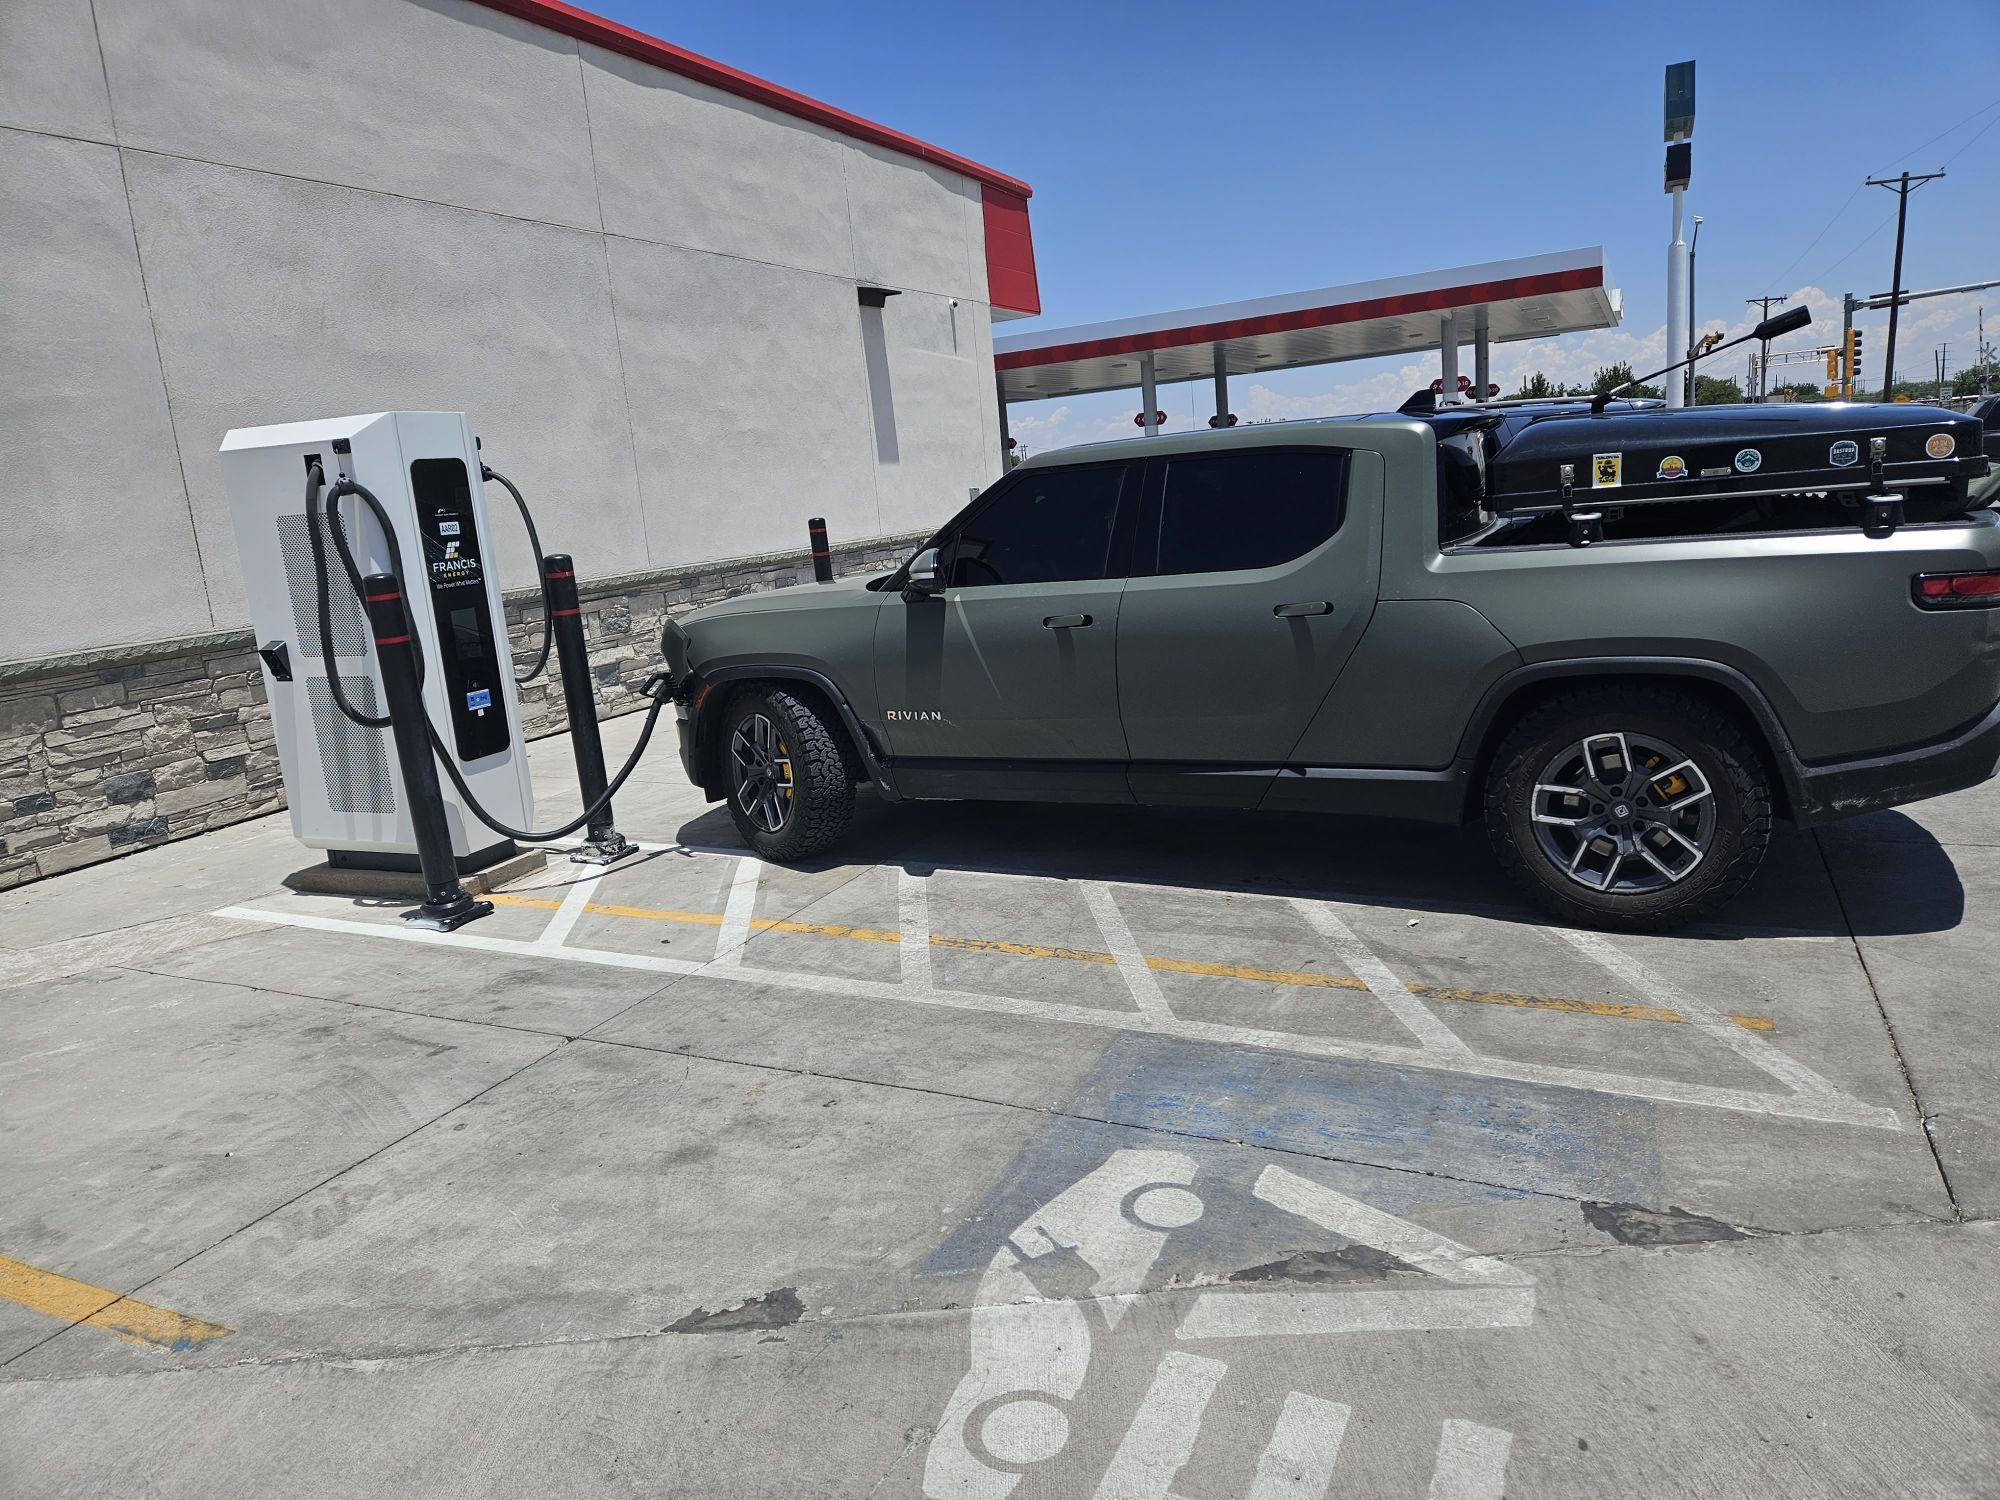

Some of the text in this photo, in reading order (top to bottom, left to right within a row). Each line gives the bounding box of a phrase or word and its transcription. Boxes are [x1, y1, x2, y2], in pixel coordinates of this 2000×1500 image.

[433, 559, 476, 572] FRANCIS
[443, 581, 456, 589] Power
[887, 710, 942, 720] RIVIAN
